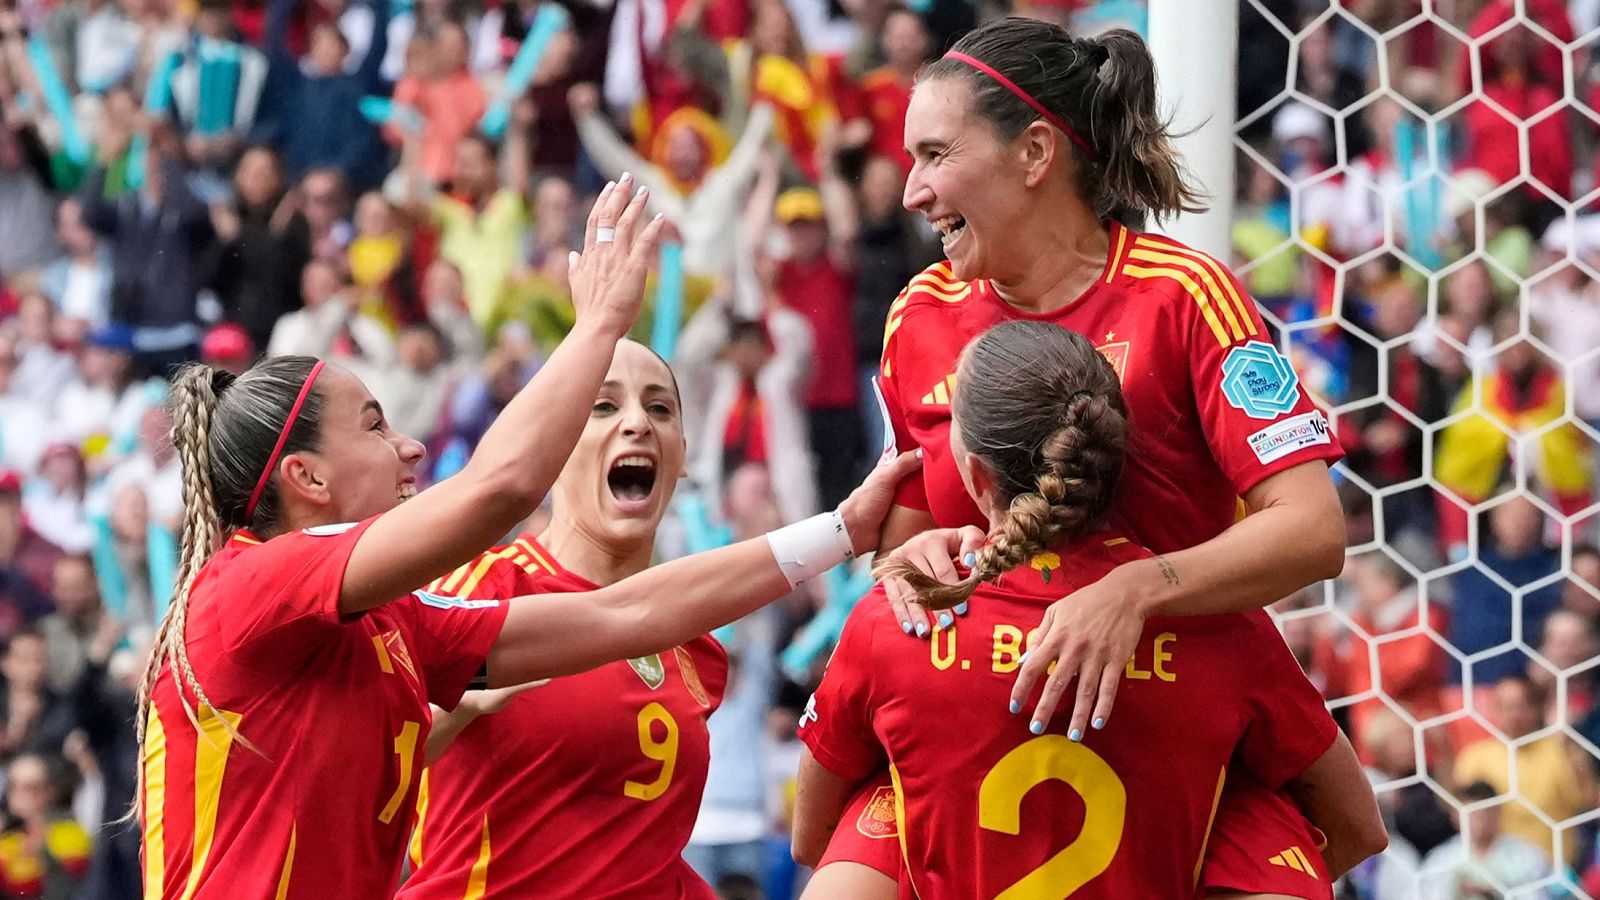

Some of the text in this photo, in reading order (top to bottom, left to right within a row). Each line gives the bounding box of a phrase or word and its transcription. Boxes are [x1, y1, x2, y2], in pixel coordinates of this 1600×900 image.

[1252, 381, 1280, 396] Strong
[1251, 433, 1267, 443] UEFA
[1255, 425, 1313, 453] FOUNDATION
[623, 701, 679, 801] 9
[978, 733, 1128, 900] 2
